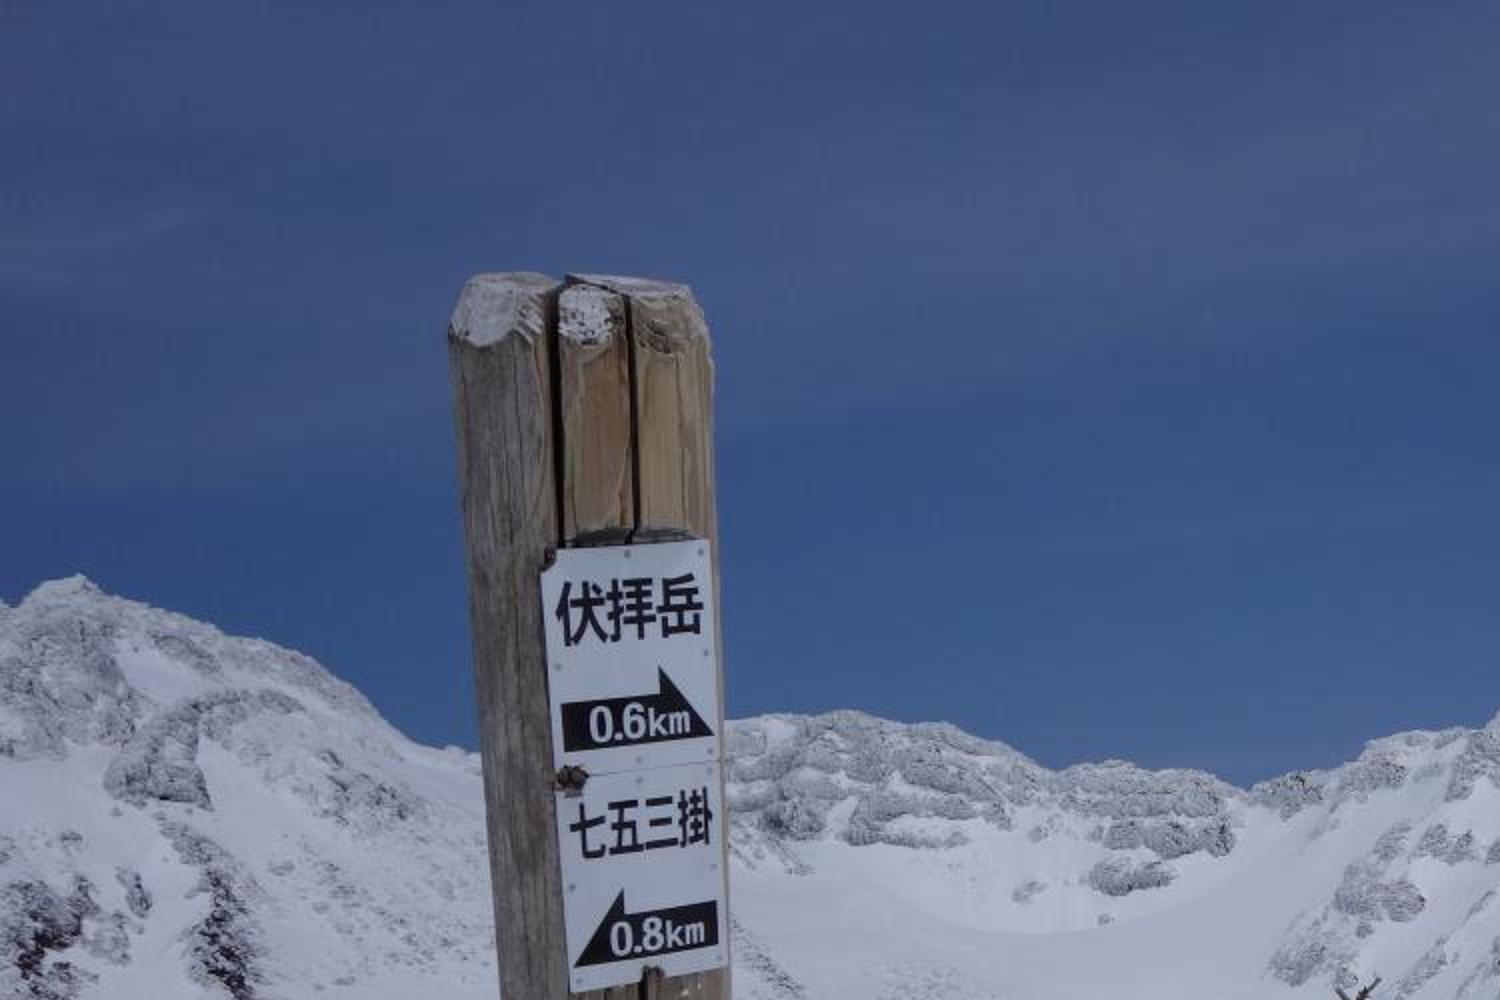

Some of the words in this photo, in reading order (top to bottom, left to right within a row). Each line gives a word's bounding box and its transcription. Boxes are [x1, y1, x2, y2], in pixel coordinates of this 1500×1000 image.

[555, 573, 704, 647] 伏拝岳
[588, 702, 691, 743] 0.6km
[569, 786, 713, 860] 七五三掛
[609, 917, 705, 957] 0.8km
